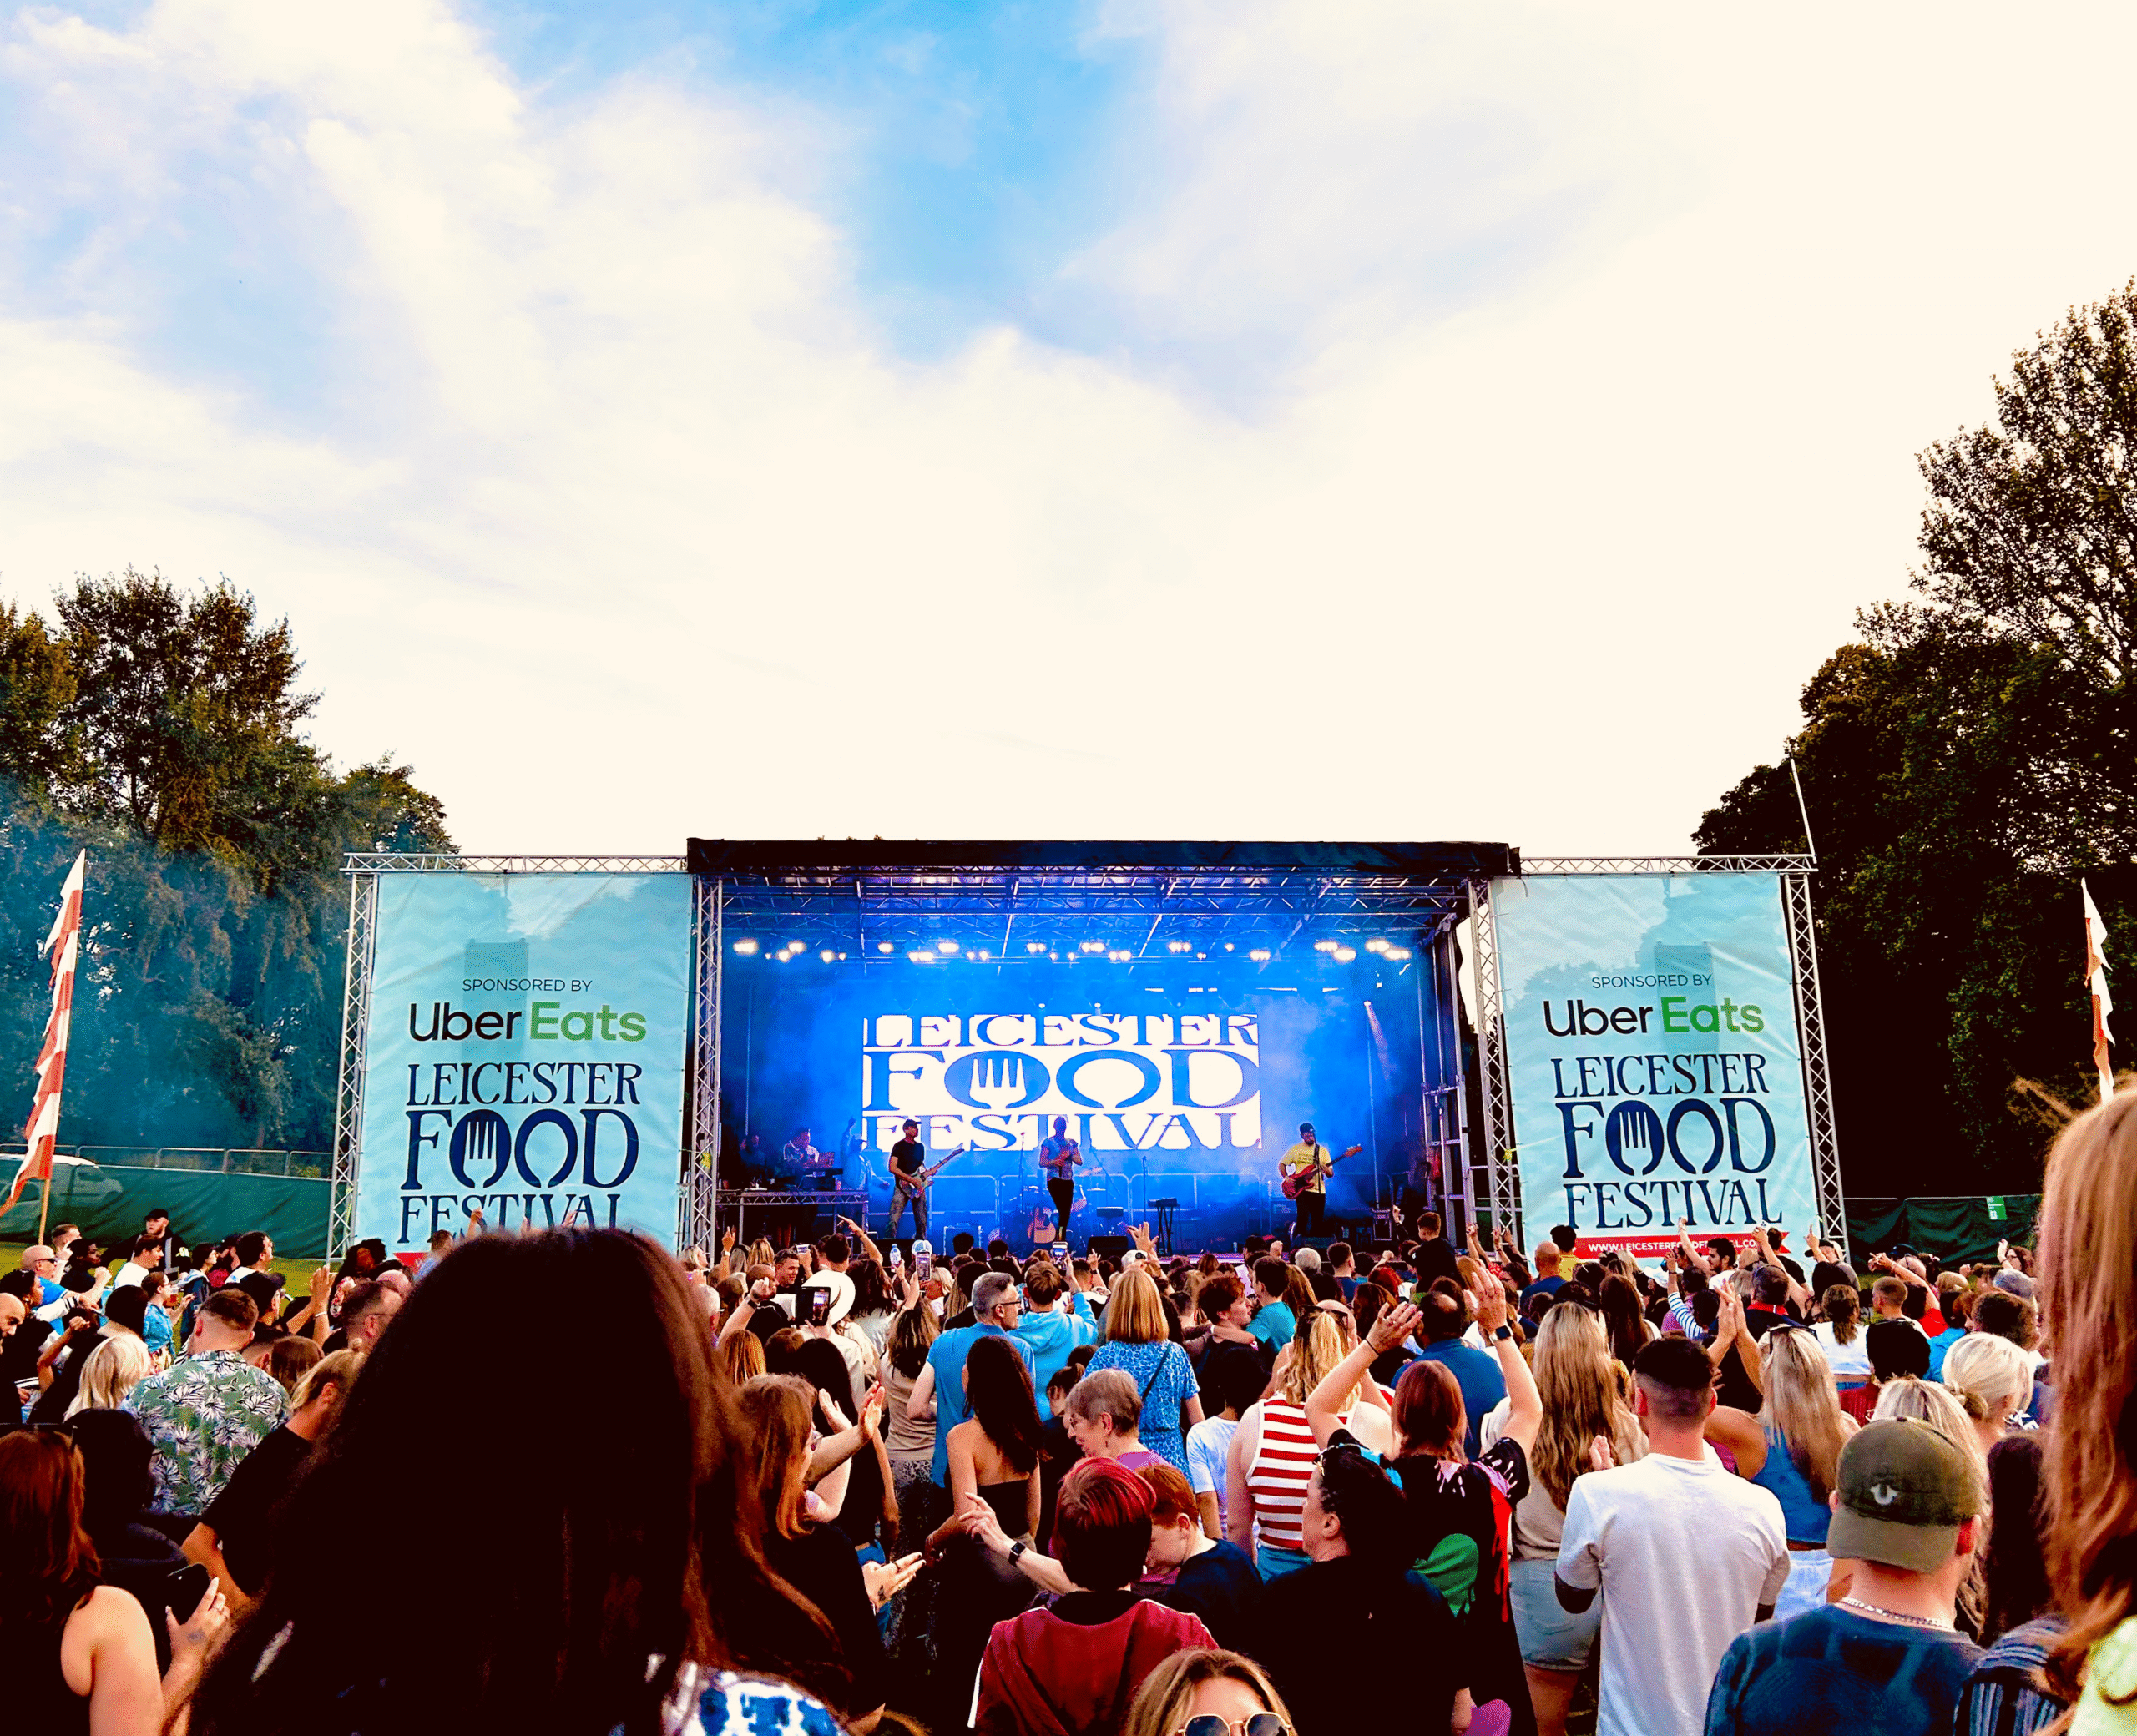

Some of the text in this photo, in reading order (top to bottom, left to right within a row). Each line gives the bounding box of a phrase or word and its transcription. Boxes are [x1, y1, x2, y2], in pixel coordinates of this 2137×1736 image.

[462, 978, 593, 992] SPONSORED BY
[1592, 974, 1713, 989] SPONSORED BY
[409, 1002, 647, 1042] Uber Eats
[864, 1014, 1258, 1047] LEICESTER
[1543, 996, 1765, 1037] Uber Eats
[406, 1062, 643, 1107] LEICESTER
[863, 1049, 1259, 1111] FOOD
[1550, 1053, 1770, 1098] LEICESTER
[401, 1108, 639, 1190] FOOD
[864, 1113, 1262, 1151] FESTIVAL
[1555, 1098, 1776, 1178] FOOD
[1563, 1178, 1782, 1229] FESTIVAL
